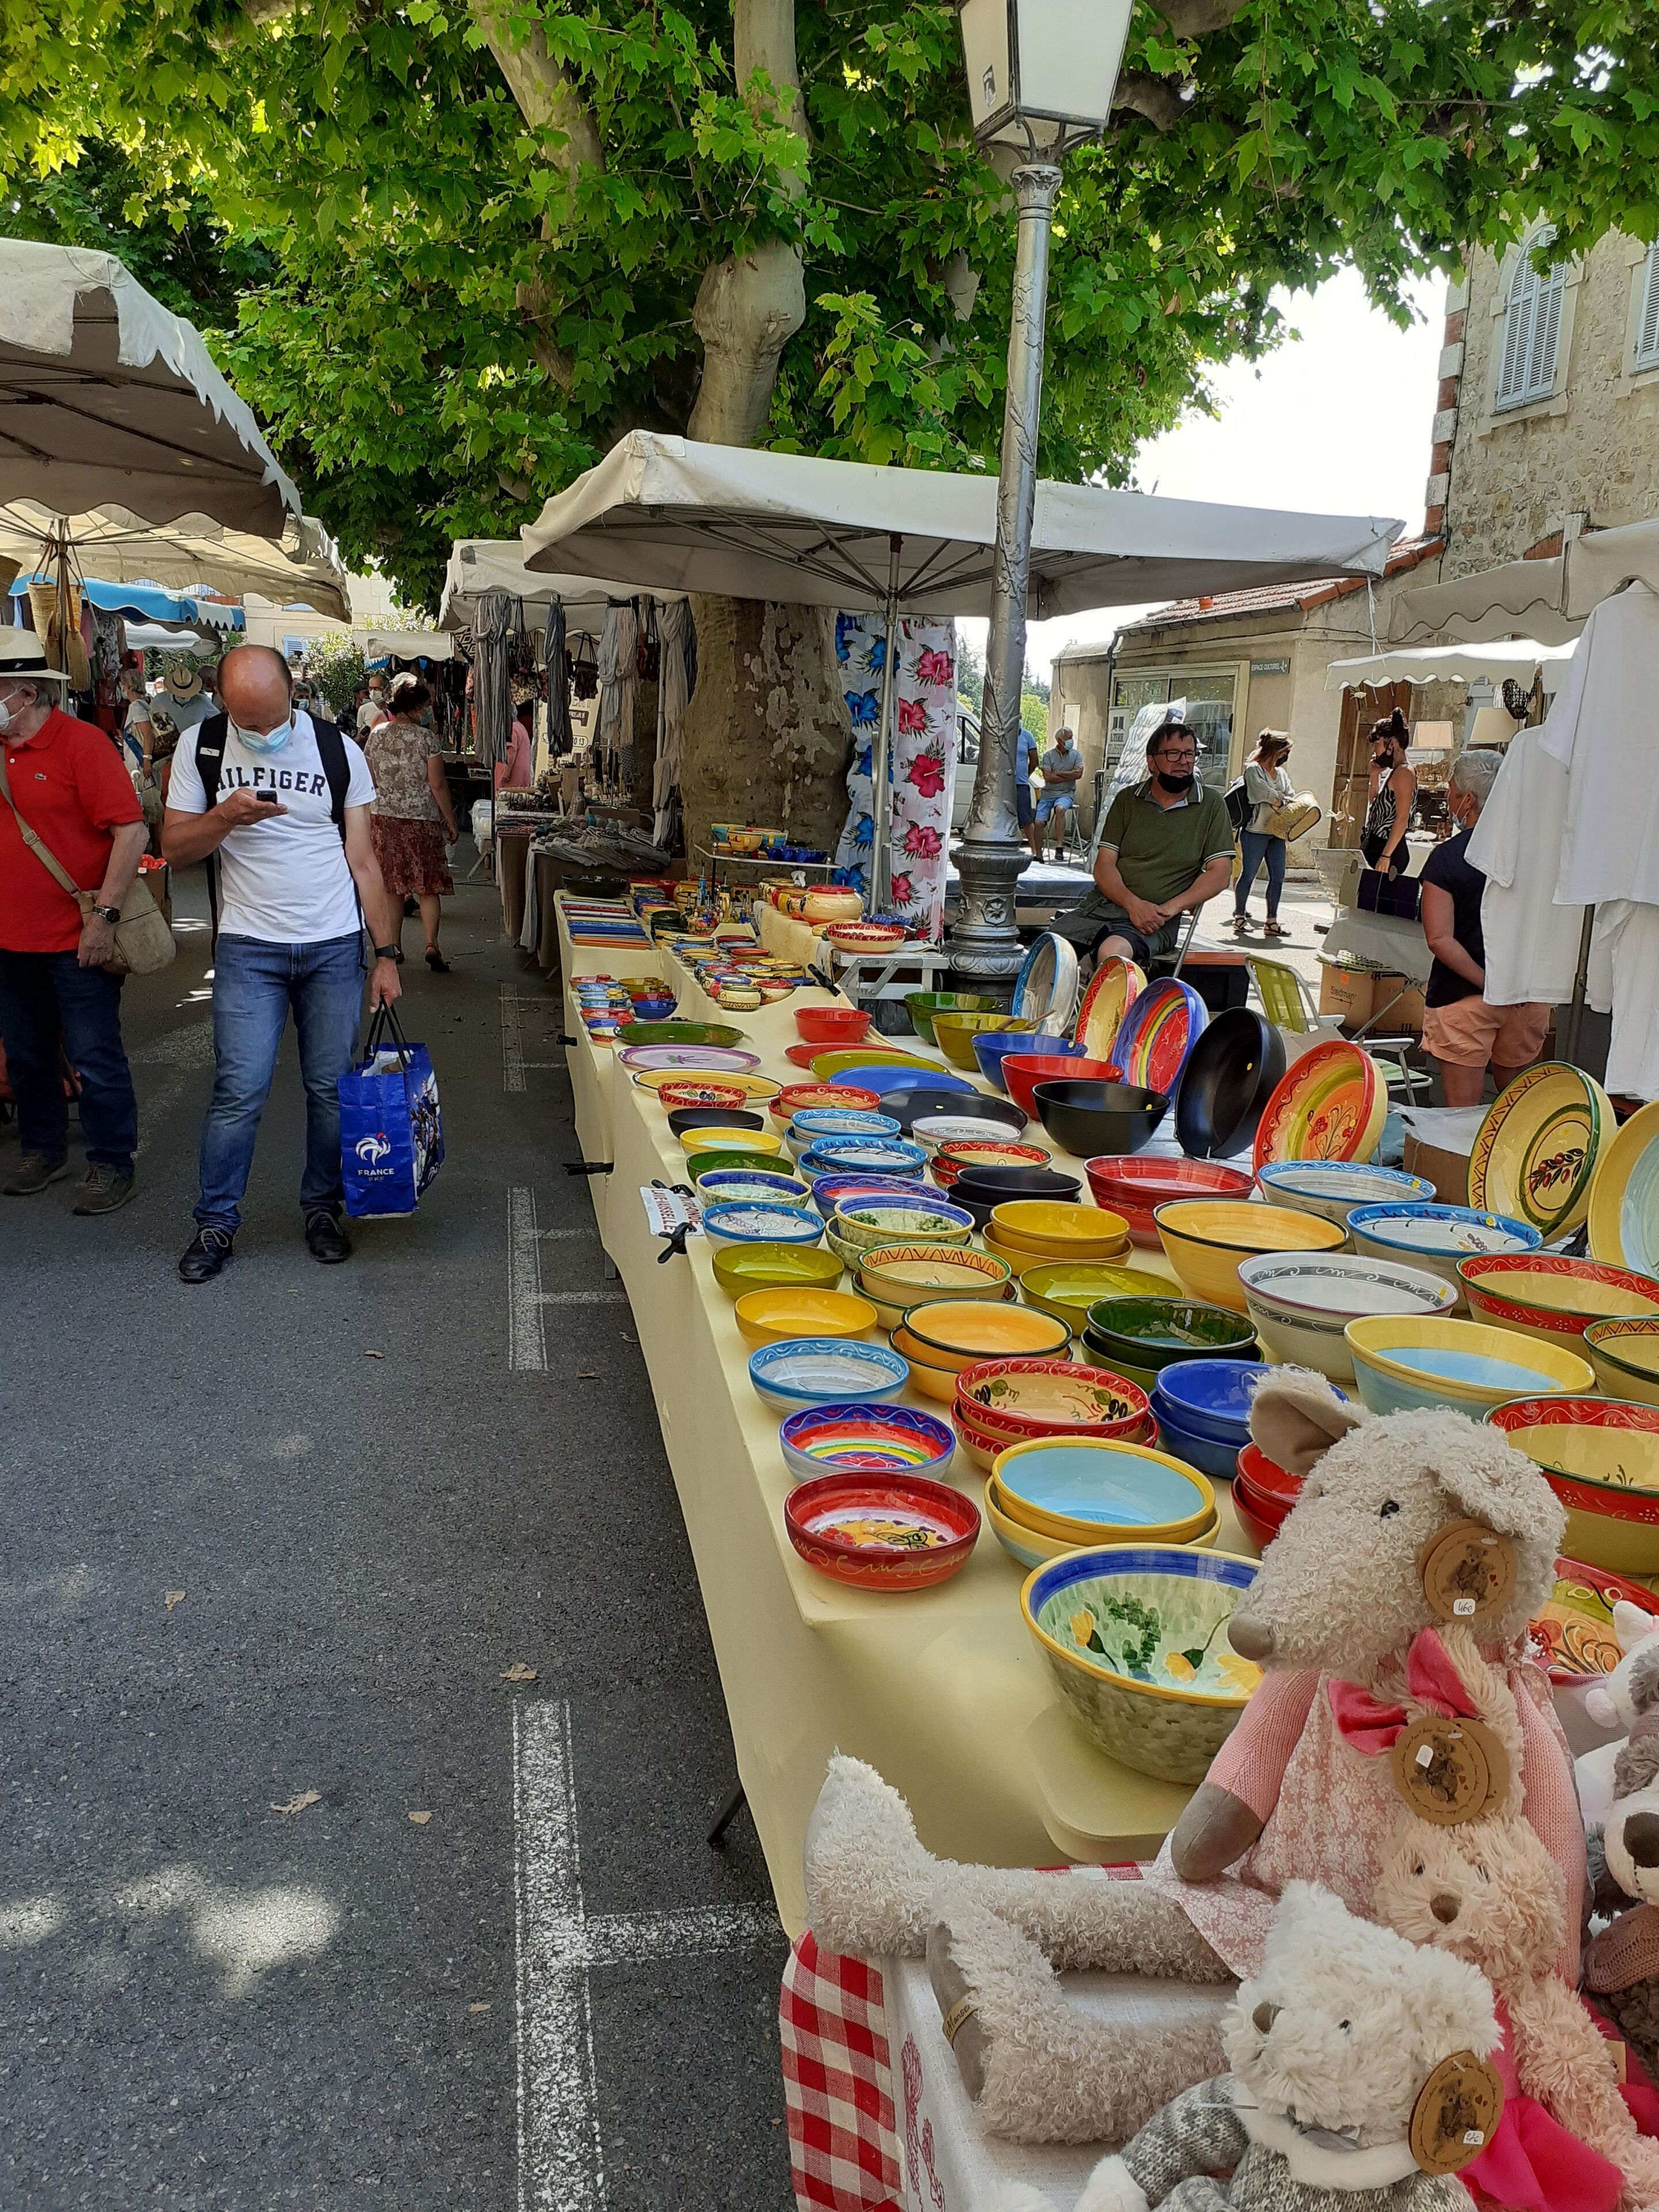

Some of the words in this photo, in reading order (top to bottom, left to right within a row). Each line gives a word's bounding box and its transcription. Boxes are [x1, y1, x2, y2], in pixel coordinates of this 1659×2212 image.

[1264, 662, 1280, 671] CULTUREL
[579, 737, 585, 745] 13
[358, 1168, 395, 1176] FRANCE
